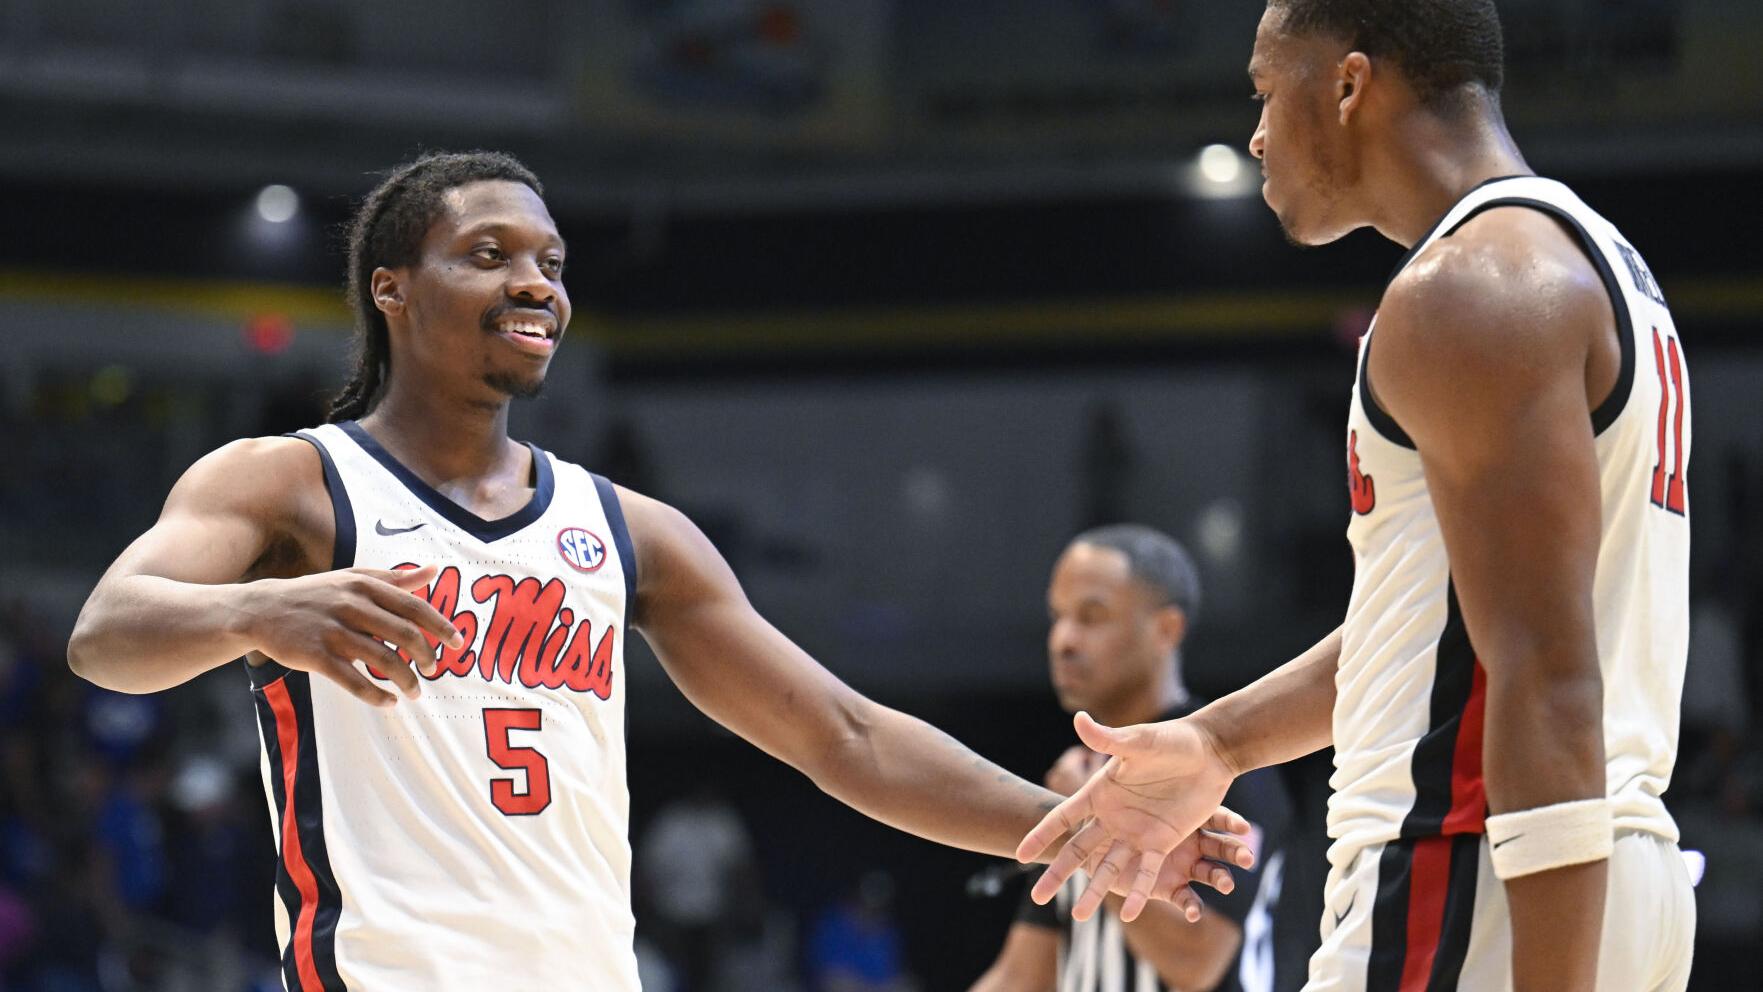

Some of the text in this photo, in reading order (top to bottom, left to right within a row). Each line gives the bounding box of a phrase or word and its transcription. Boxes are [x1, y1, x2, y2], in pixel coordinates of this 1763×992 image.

[1650, 326, 1685, 517] 11
[558, 528, 606, 571] SEC
[471, 574, 615, 700] Miss
[482, 708, 552, 816] 5
